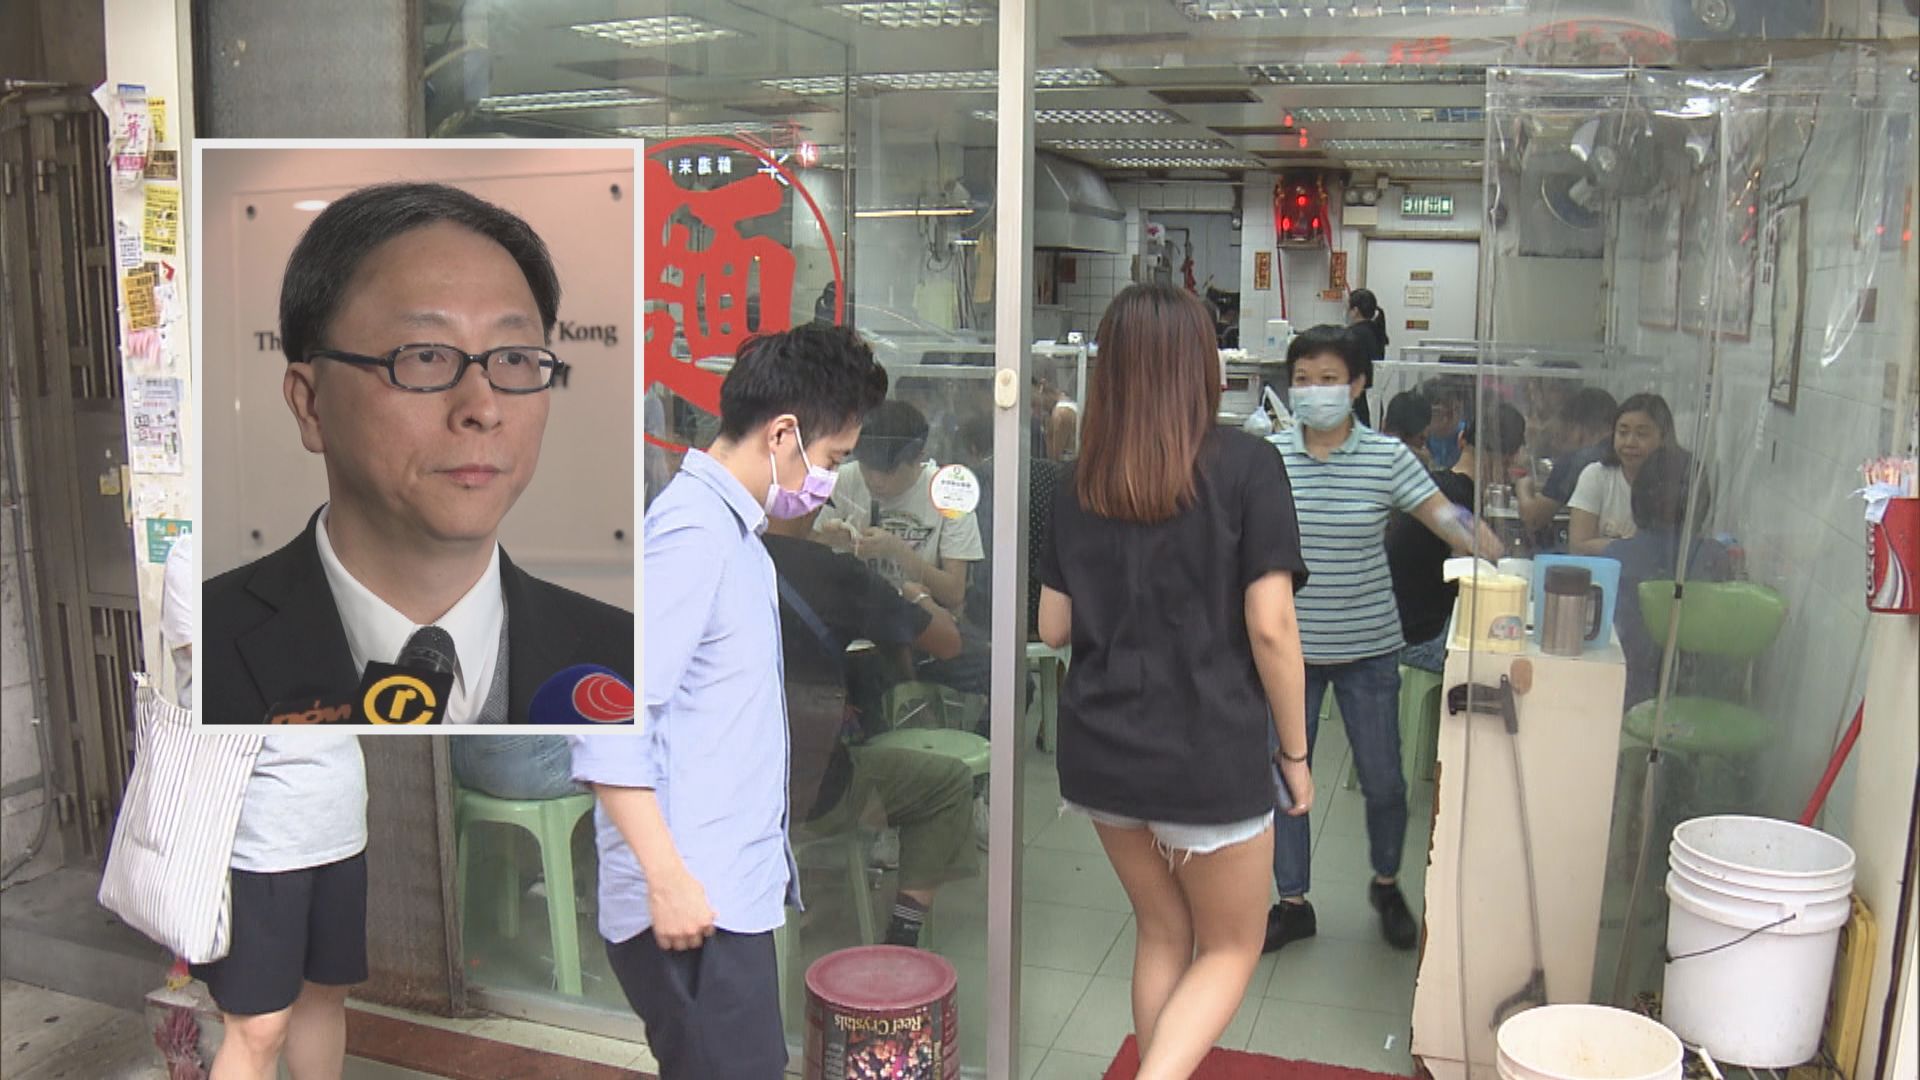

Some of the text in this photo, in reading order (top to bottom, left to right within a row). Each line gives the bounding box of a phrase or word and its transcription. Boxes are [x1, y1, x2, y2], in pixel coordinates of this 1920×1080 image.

[1402, 196, 1427, 214] EXIT
[1428, 195, 1453, 214] 出口
[253, 331, 282, 351] Th
[559, 321, 618, 347] Kong
[833, 1014, 921, 1036] Reef Crystals
